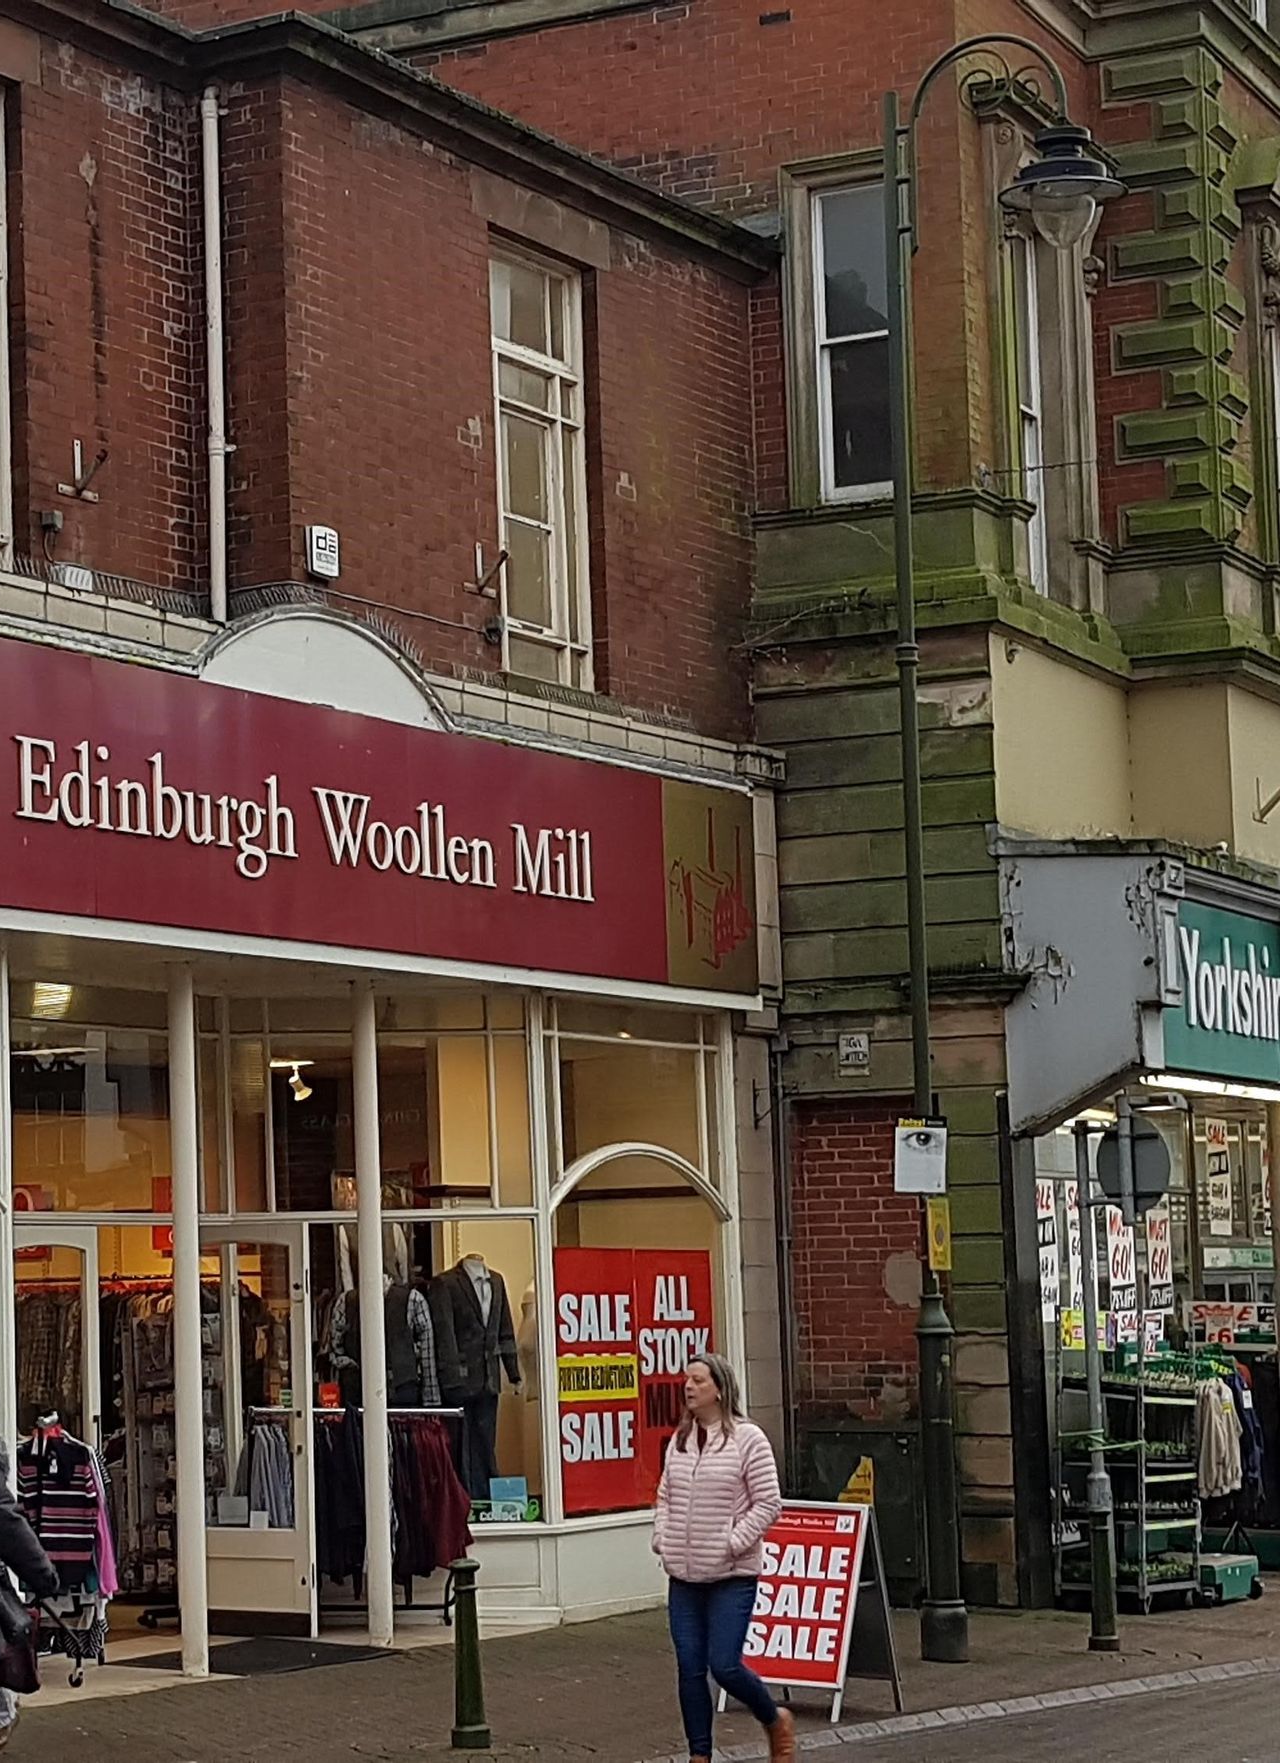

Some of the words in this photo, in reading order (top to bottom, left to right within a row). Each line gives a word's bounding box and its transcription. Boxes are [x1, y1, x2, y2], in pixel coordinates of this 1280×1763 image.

[13, 733, 299, 879] Edinburgh
[312, 785, 498, 889] Woollen
[511, 822, 597, 903] Mill
[558, 1293, 632, 1343] SALE
[653, 1275, 695, 1322] ALL
[638, 1327, 710, 1376] STOCK
[559, 1366, 590, 1392] FURTHER
[591, 1364, 634, 1390] REDUCTIONS
[561, 1411, 634, 1463] SALE
[761, 1541, 851, 1581] SALE
[753, 1581, 845, 1622] SALE
[742, 1621, 839, 1663] SALE
